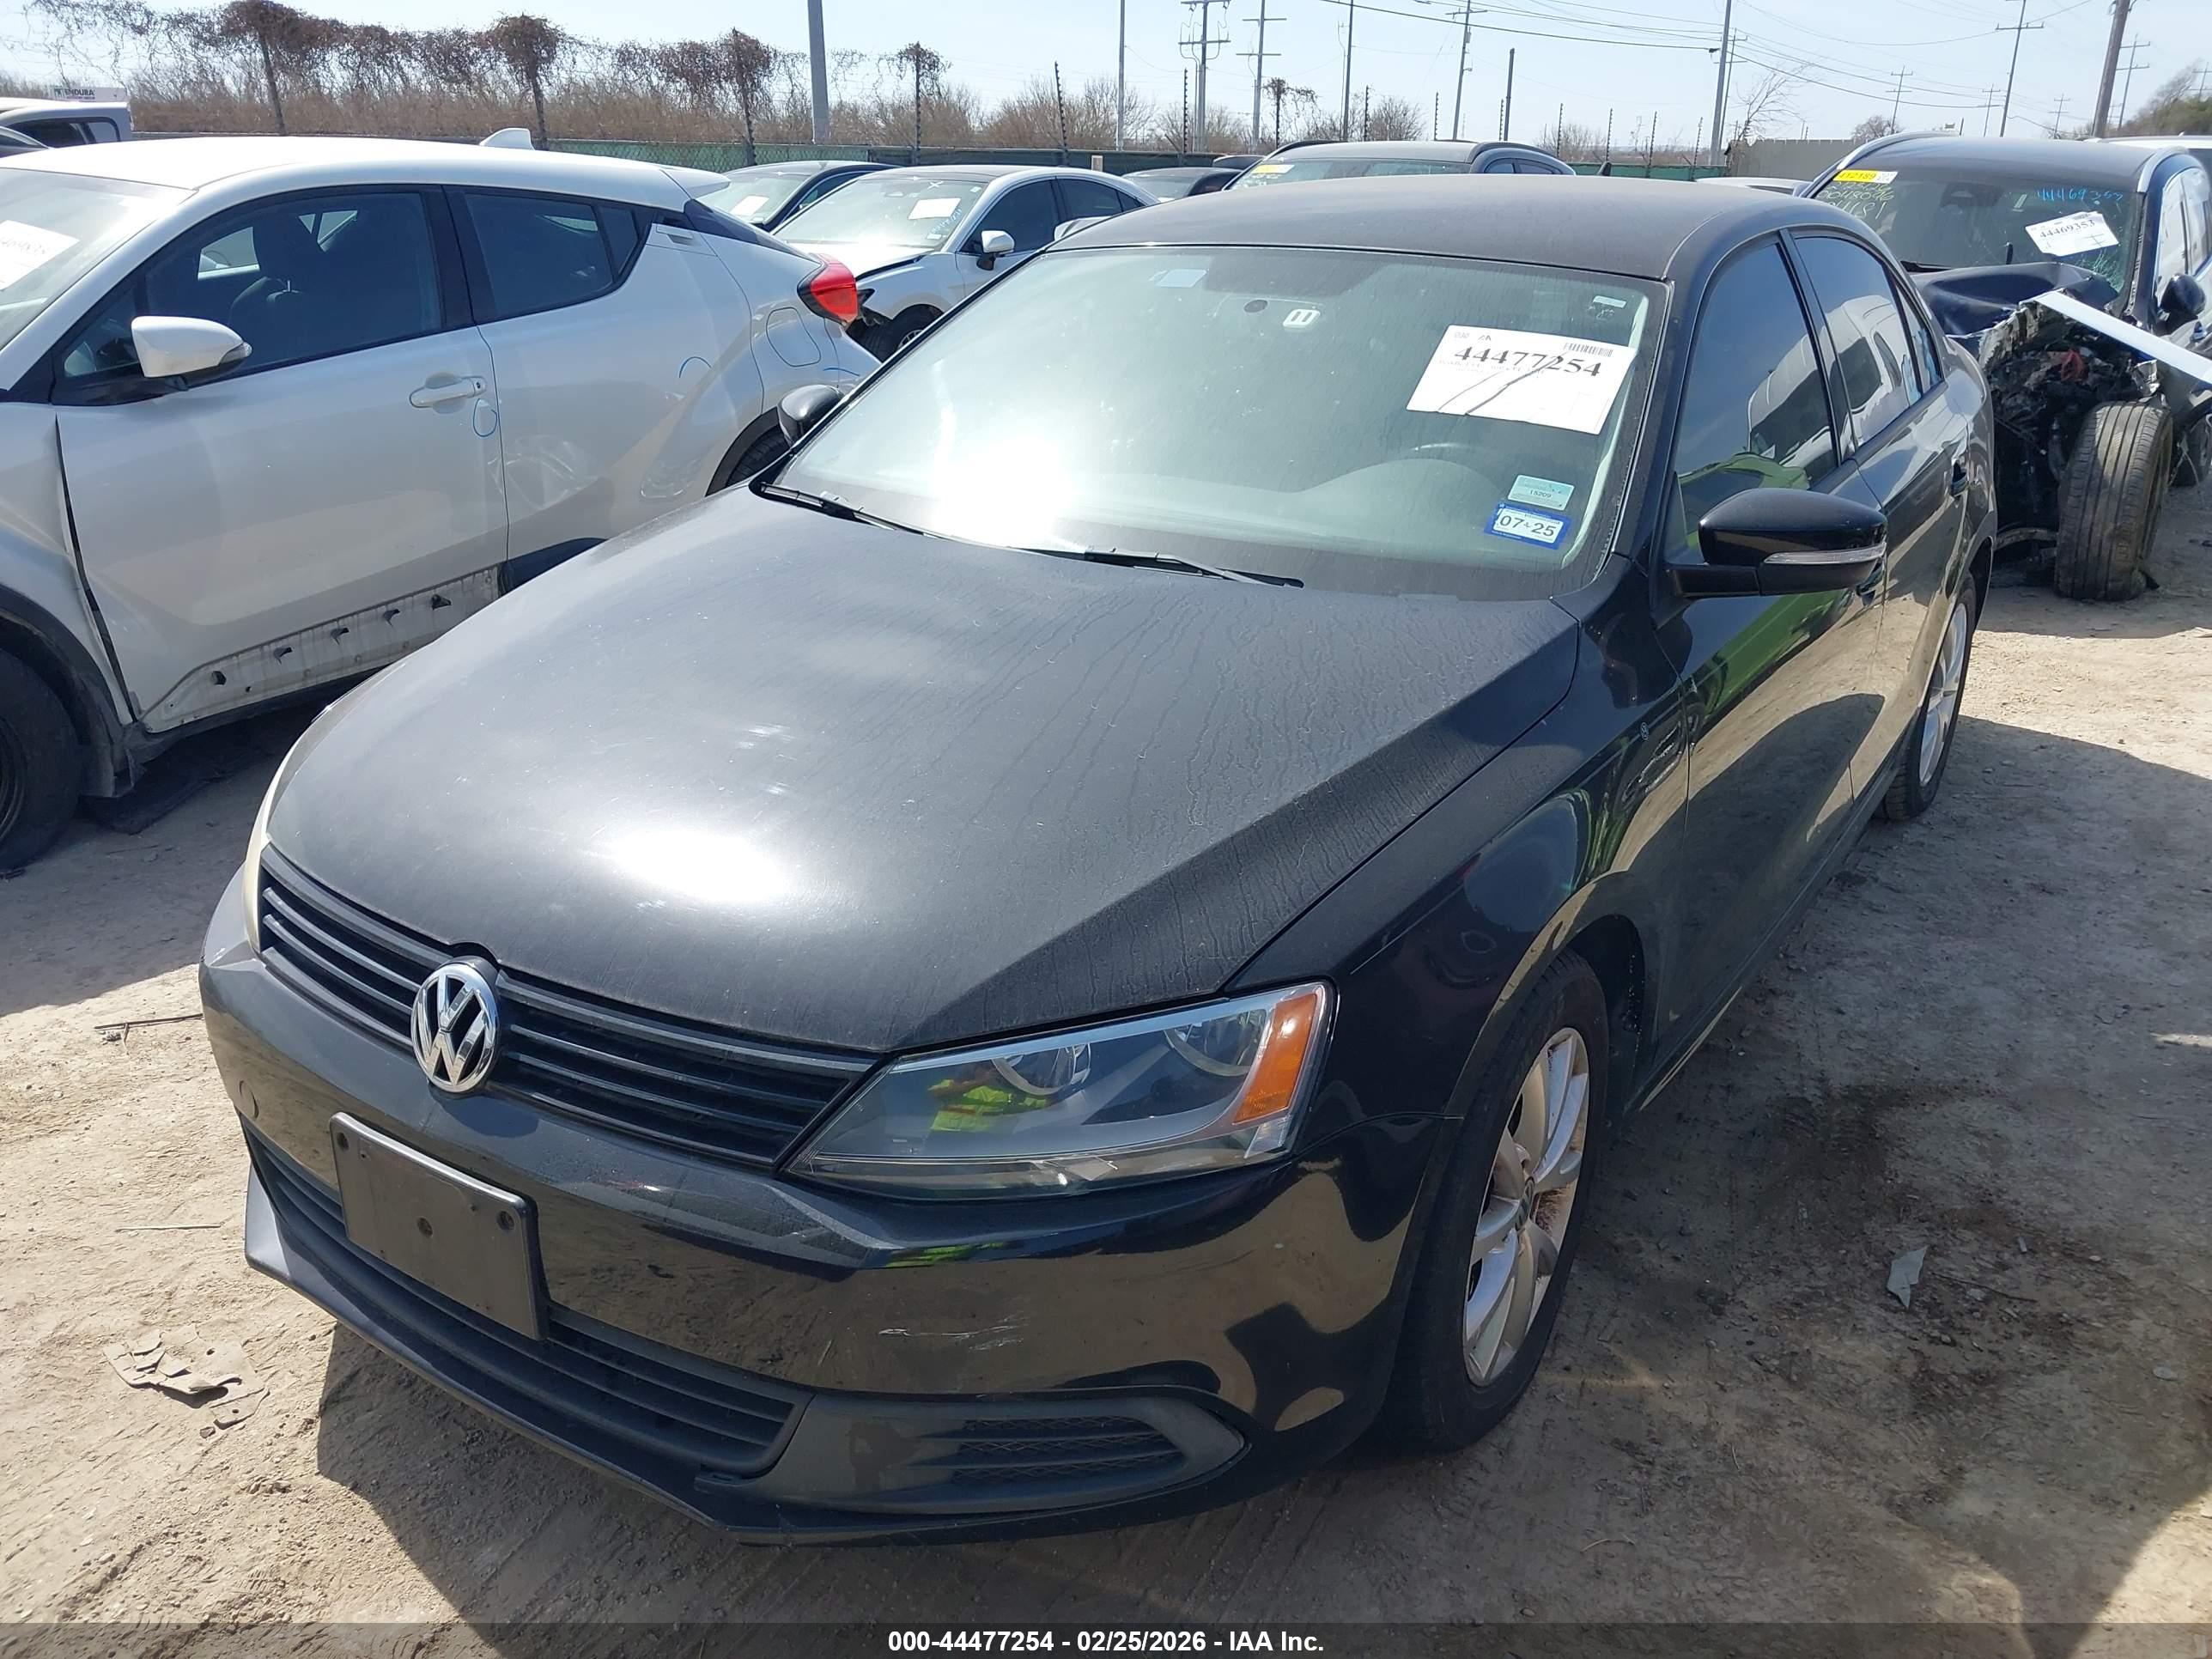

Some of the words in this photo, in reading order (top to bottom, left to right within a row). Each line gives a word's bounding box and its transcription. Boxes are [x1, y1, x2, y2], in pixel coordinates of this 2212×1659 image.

[2039, 219, 2096, 239] 44469353
[1455, 346, 1602, 377] 44477254
[1499, 515, 1525, 529] 07
[1531, 522, 1557, 537] 25
